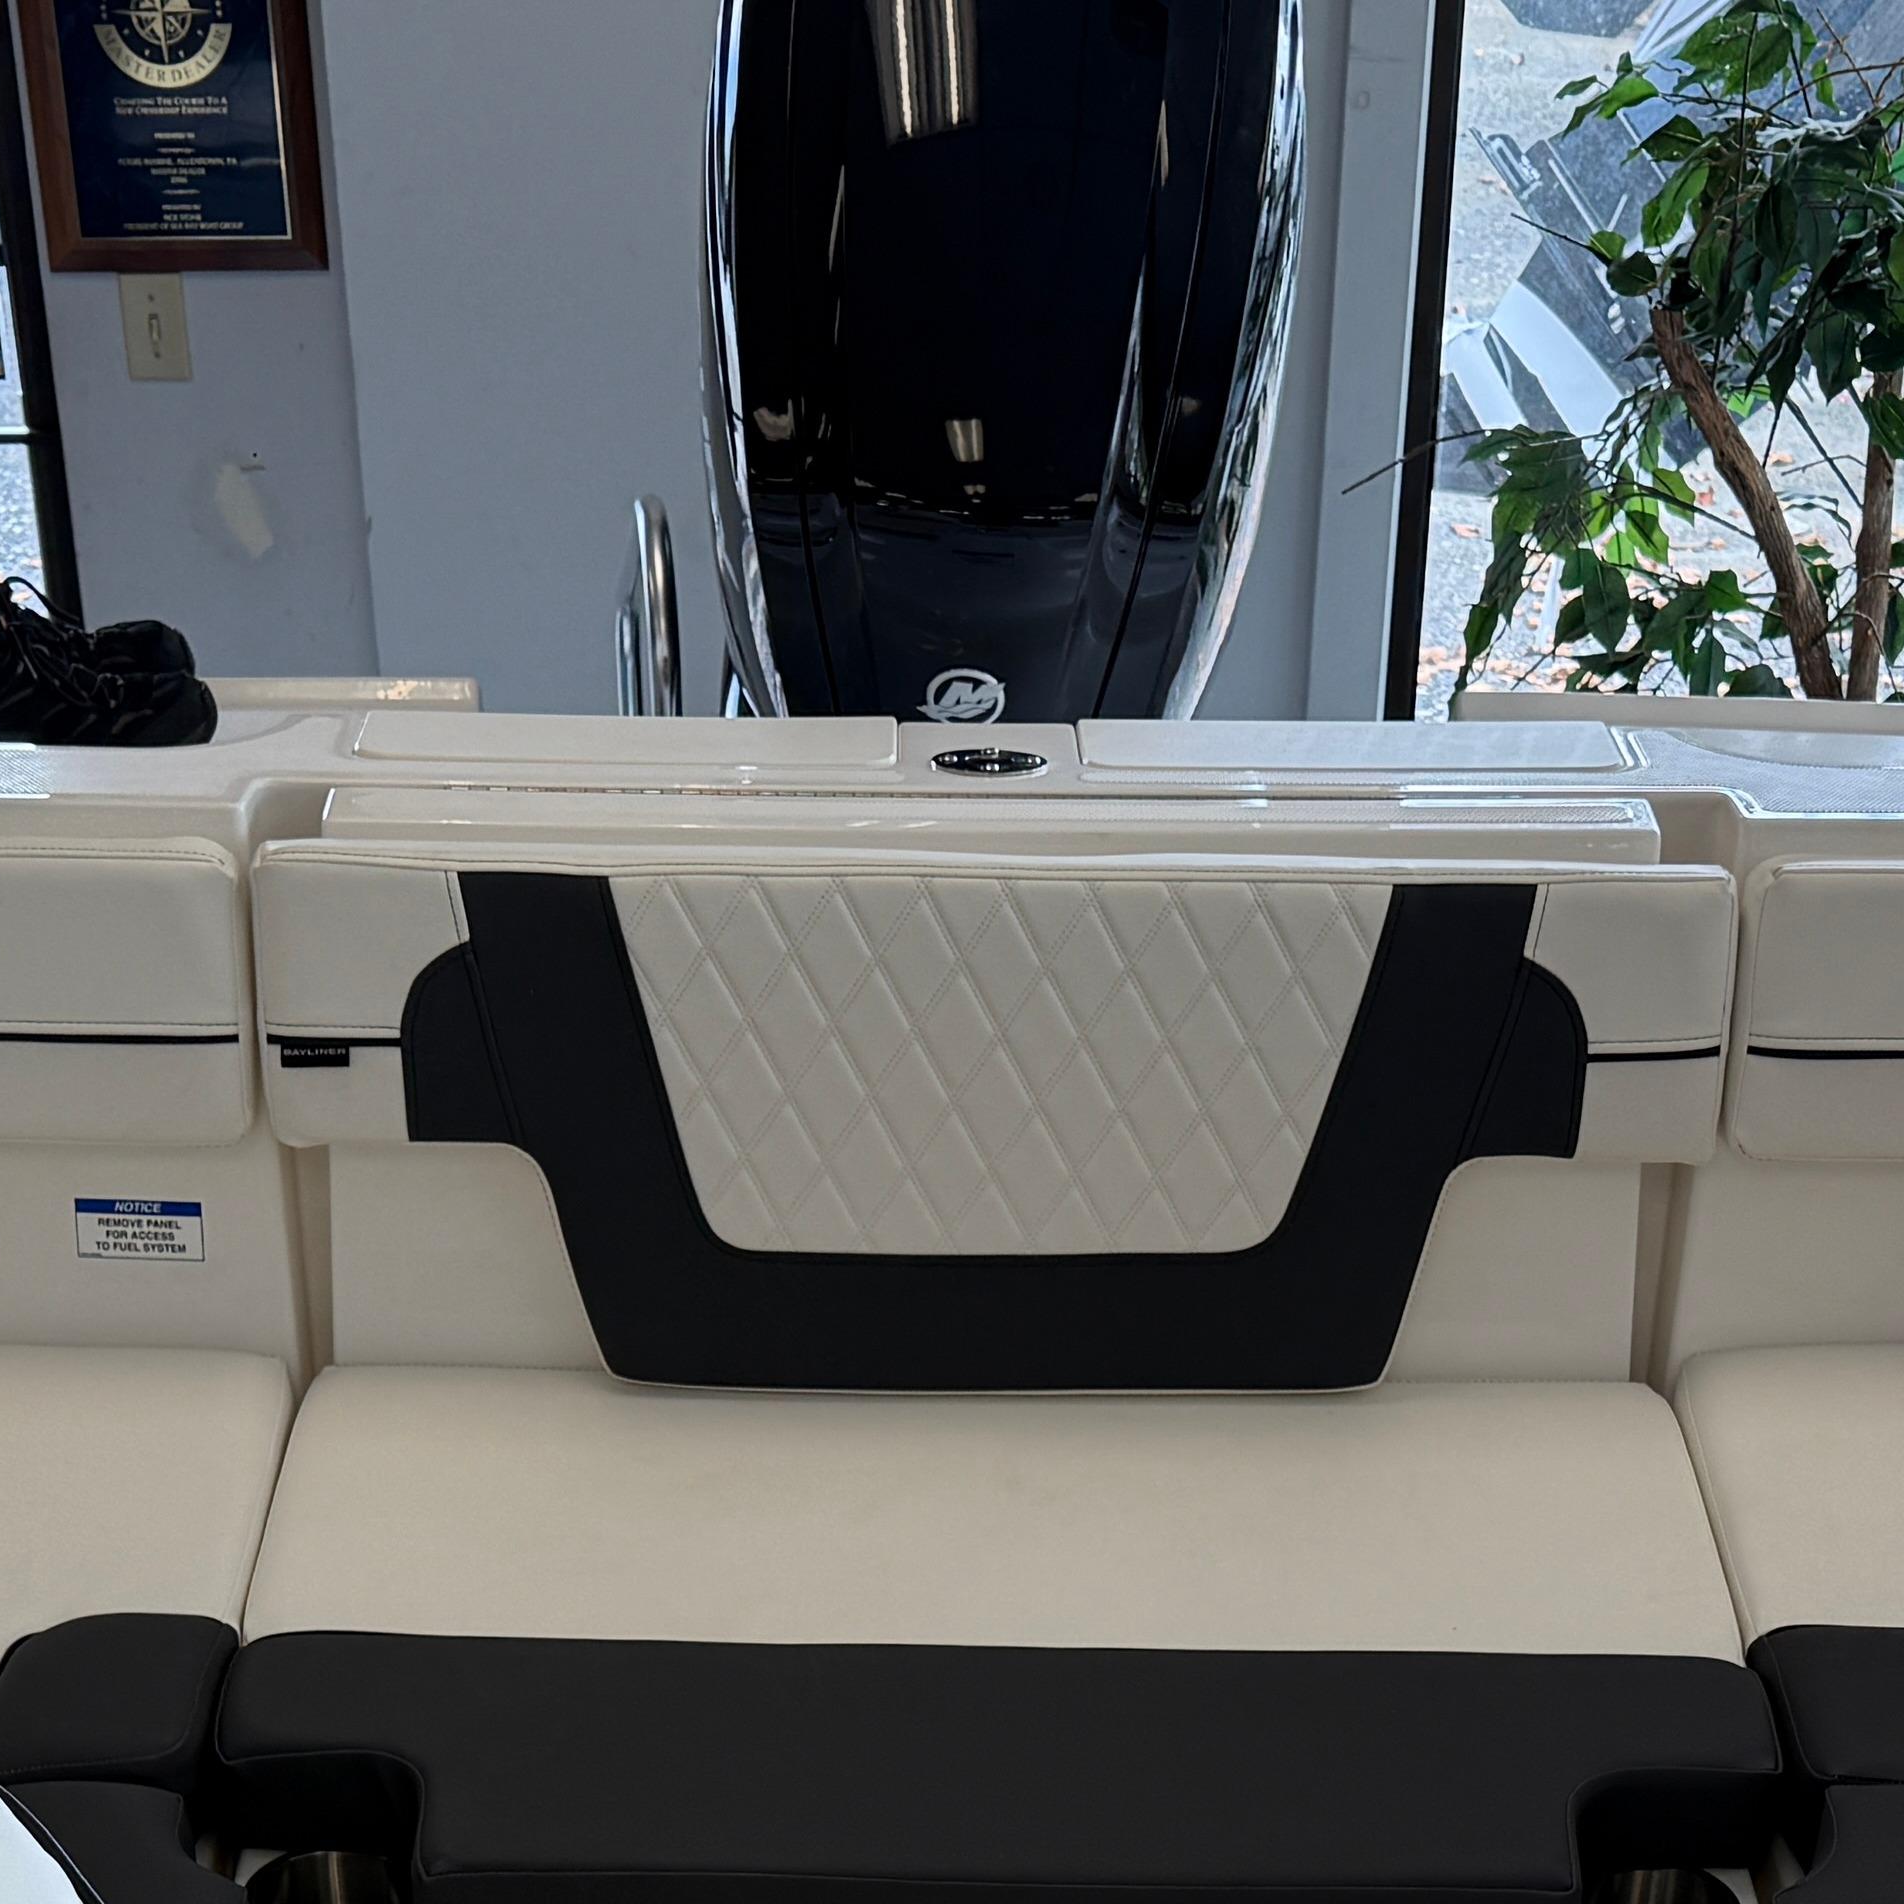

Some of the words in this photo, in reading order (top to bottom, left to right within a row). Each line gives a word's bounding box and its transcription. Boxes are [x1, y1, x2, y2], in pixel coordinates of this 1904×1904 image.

[102, 28, 166, 83] MASTER
[170, 28, 227, 83] DEALER
[283, 1047, 346, 1057] BAYLINER
[114, 1201, 162, 1214] NOTICE
[97, 1217, 144, 1228] REMOVE
[146, 1219, 182, 1230] PANEL
[105, 1229, 128, 1239] FOR
[131, 1230, 175, 1241] ACCESS
[95, 1241, 110, 1251] TO
[113, 1242, 140, 1252] FUEL
[142, 1243, 187, 1253] SYSTEM
